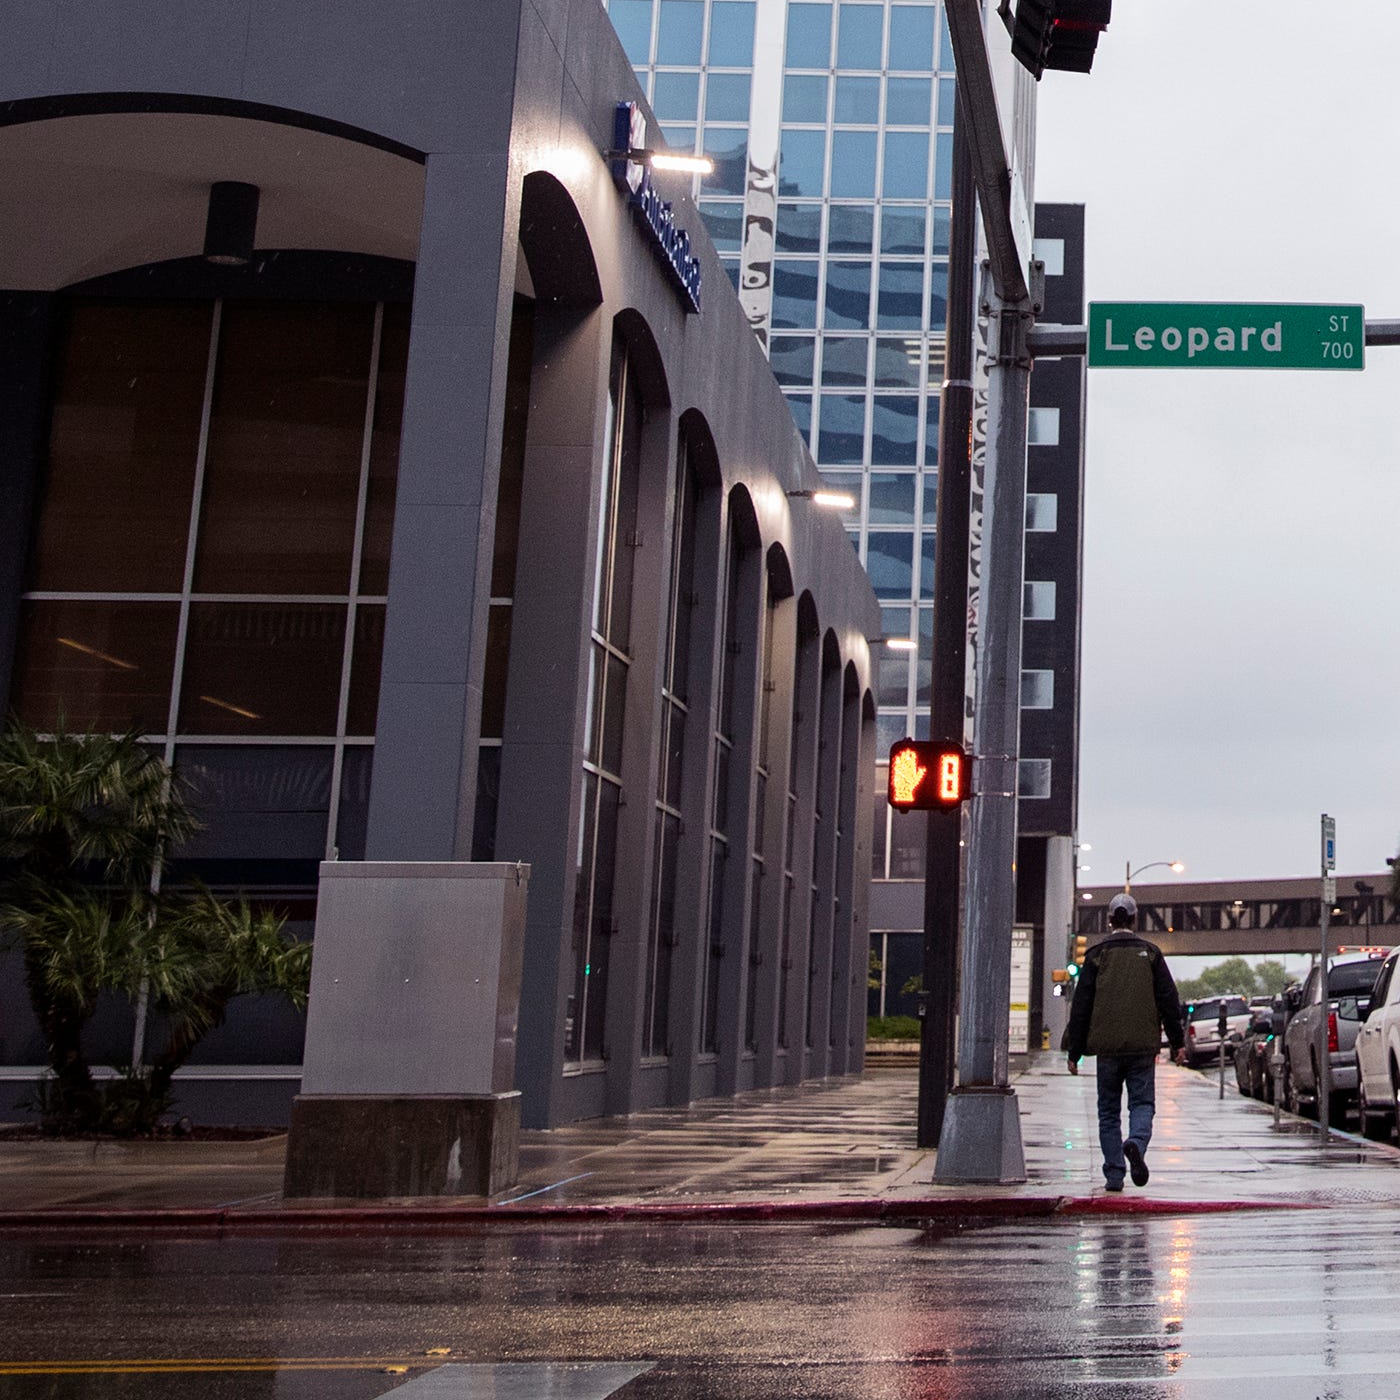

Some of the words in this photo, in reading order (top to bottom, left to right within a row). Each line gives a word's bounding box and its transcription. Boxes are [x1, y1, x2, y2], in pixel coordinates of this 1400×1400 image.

[1104, 318, 1283, 358] Leopard
[1328, 314, 1350, 333] ST
[1320, 341, 1354, 360] 700
[940, 754, 960, 799] 8
